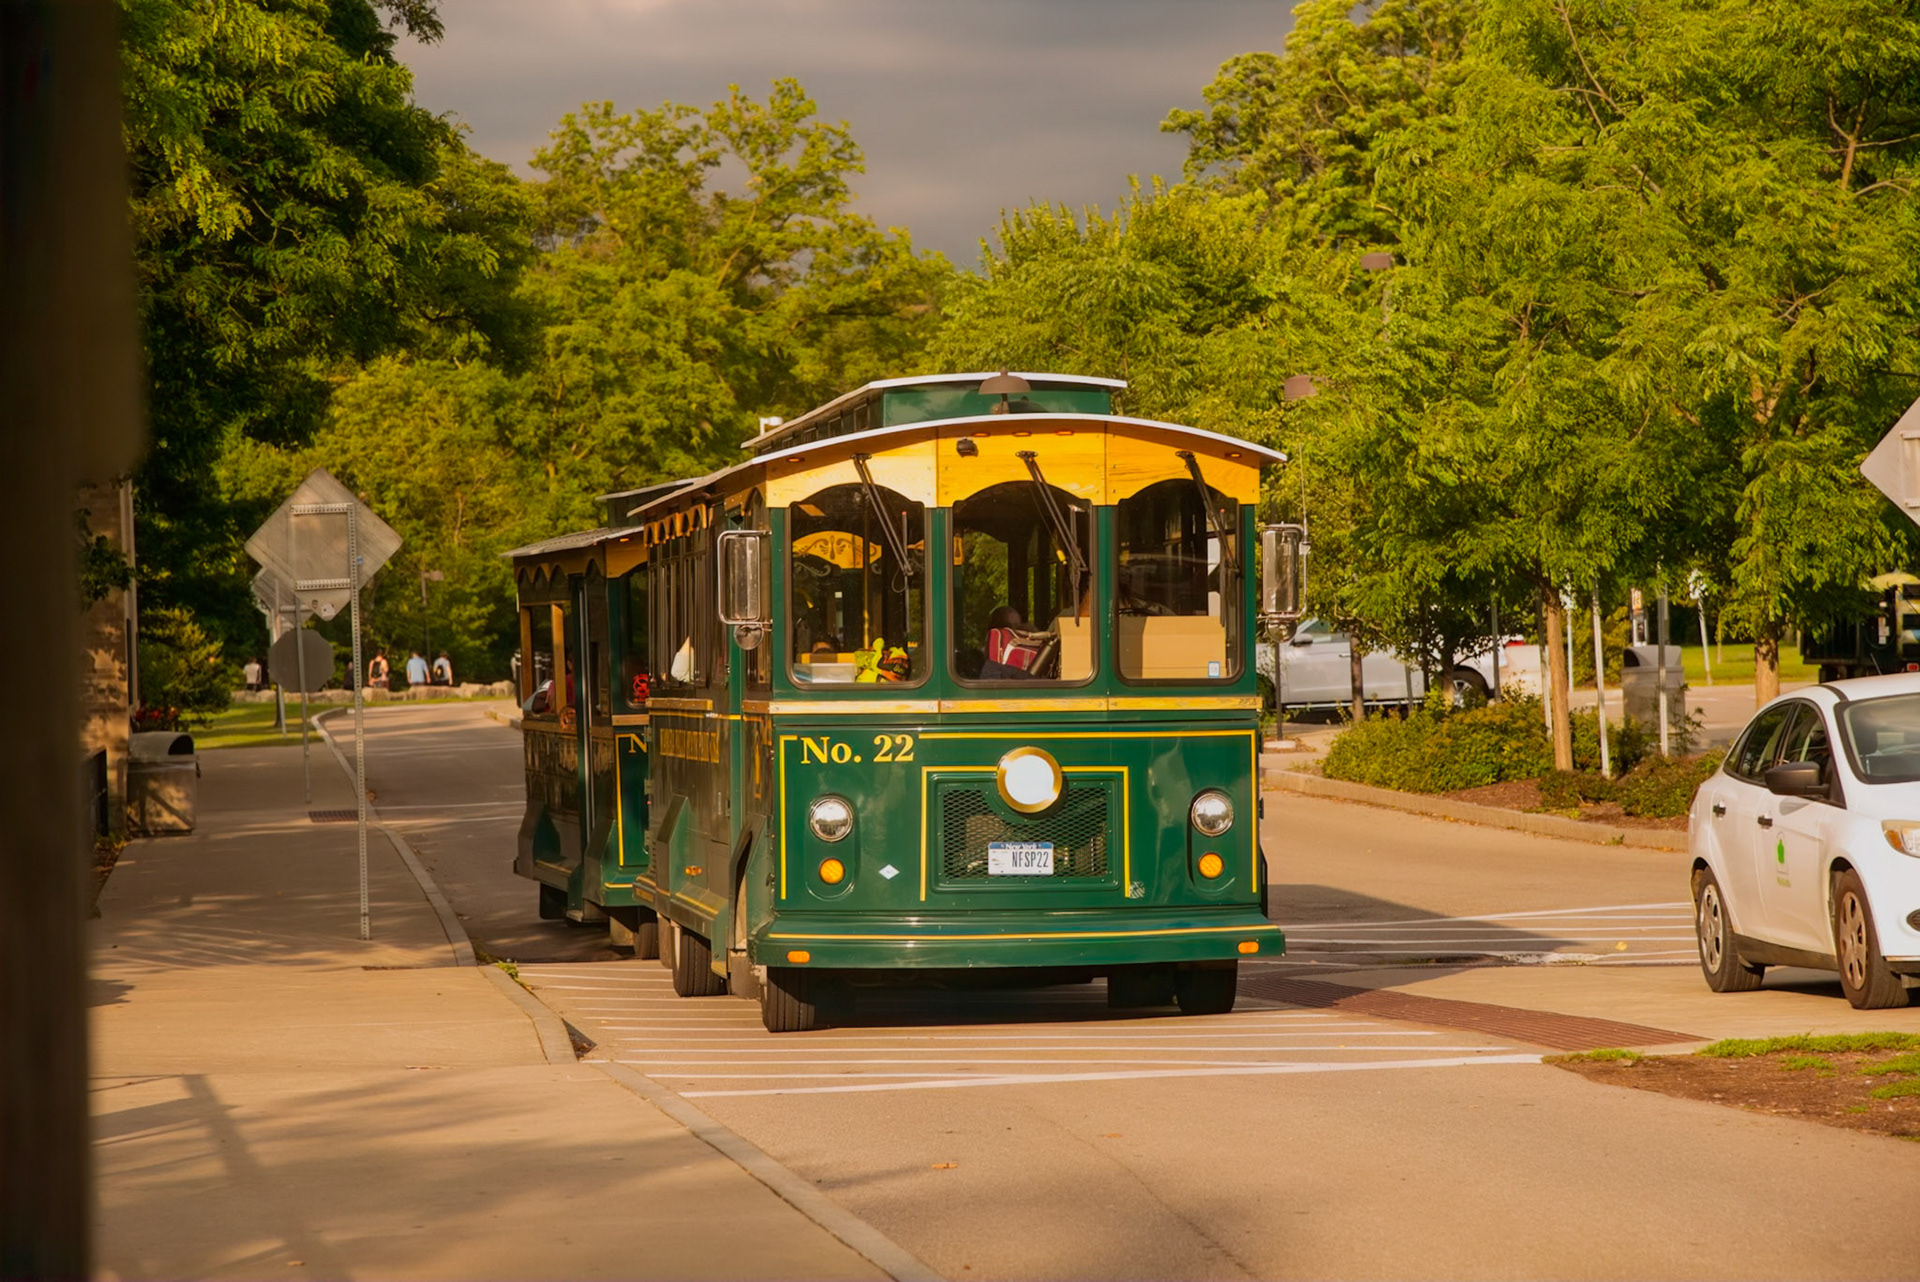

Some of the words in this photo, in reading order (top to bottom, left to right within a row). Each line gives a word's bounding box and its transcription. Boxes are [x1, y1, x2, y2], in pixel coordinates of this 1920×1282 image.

[800, 736, 862, 764] No.
[873, 733, 915, 763] 22
[1012, 851, 1049, 868] NFSP22
